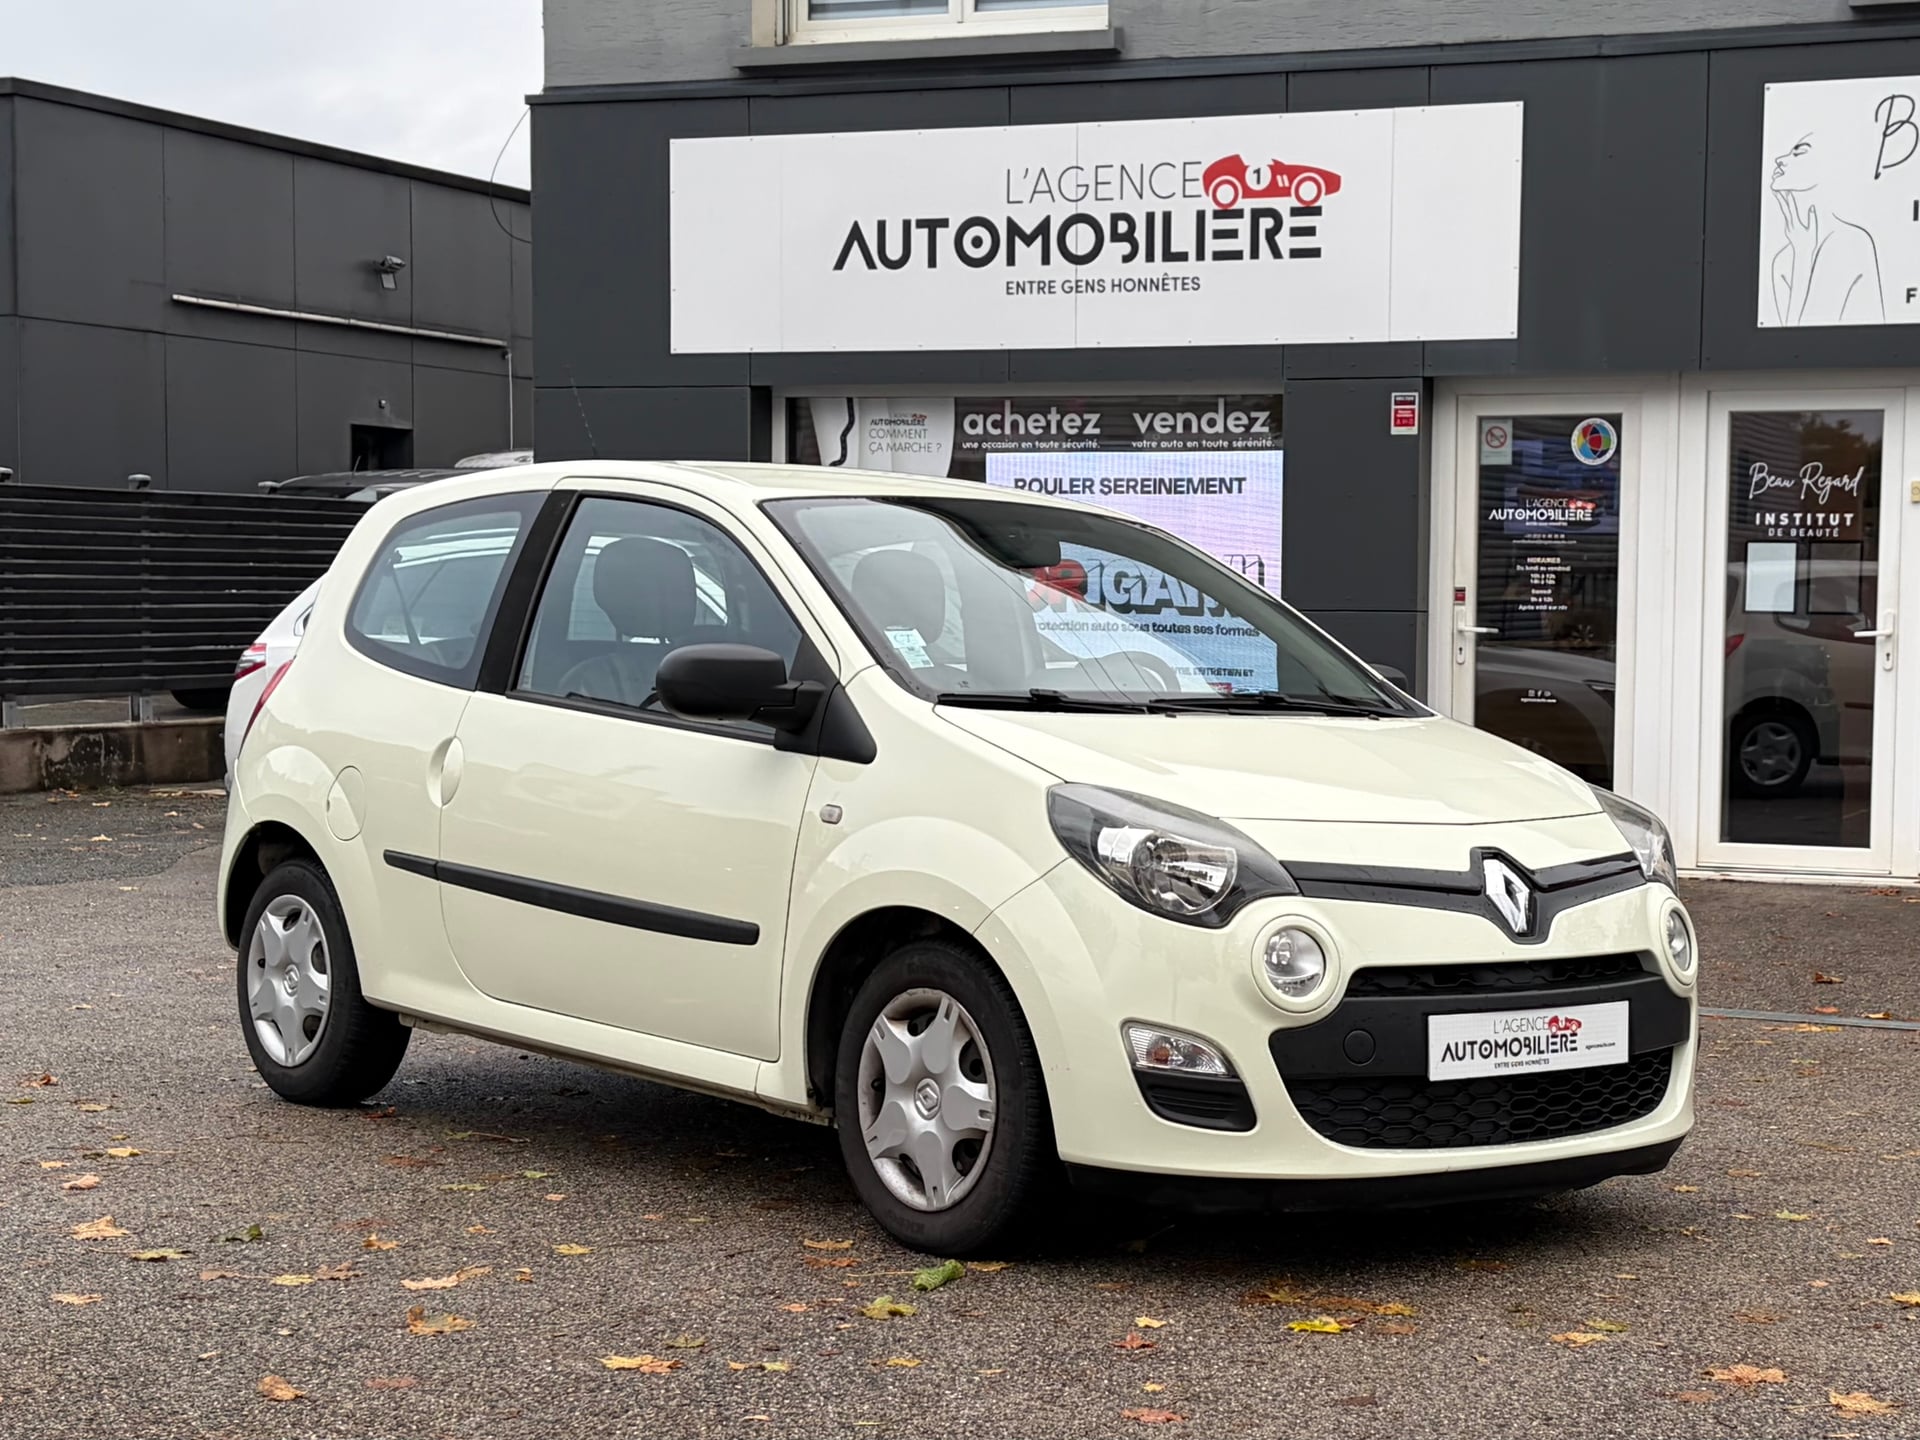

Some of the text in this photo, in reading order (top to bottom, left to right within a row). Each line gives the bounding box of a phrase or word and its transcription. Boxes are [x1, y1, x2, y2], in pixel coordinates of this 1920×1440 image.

[1006, 161, 1202, 204] L'AGENCE
[1005, 272, 1202, 296] ENTRE GENS HONNÊTES
[962, 400, 1102, 436] achetez
[1132, 397, 1271, 434] vendez
[868, 428, 929, 440] COMMENT
[868, 441, 943, 454] ÇA MARCHE ?
[961, 438, 1101, 449] une occasion en toute sécurité.
[1131, 437, 1276, 449] votre auto en toute sérénité.
[1013, 476, 1248, 496] ROULER SEREINEMENT
[1748, 461, 1865, 505] Beau Regard
[1525, 498, 1569, 508] L'AGENCE
[1755, 512, 1855, 526] INSTITUT
[1767, 526, 1840, 537] DE BEAUTÉ
[1151, 622, 1191, 635] toutes
[1493, 1016, 1549, 1034] L'AGENCE
